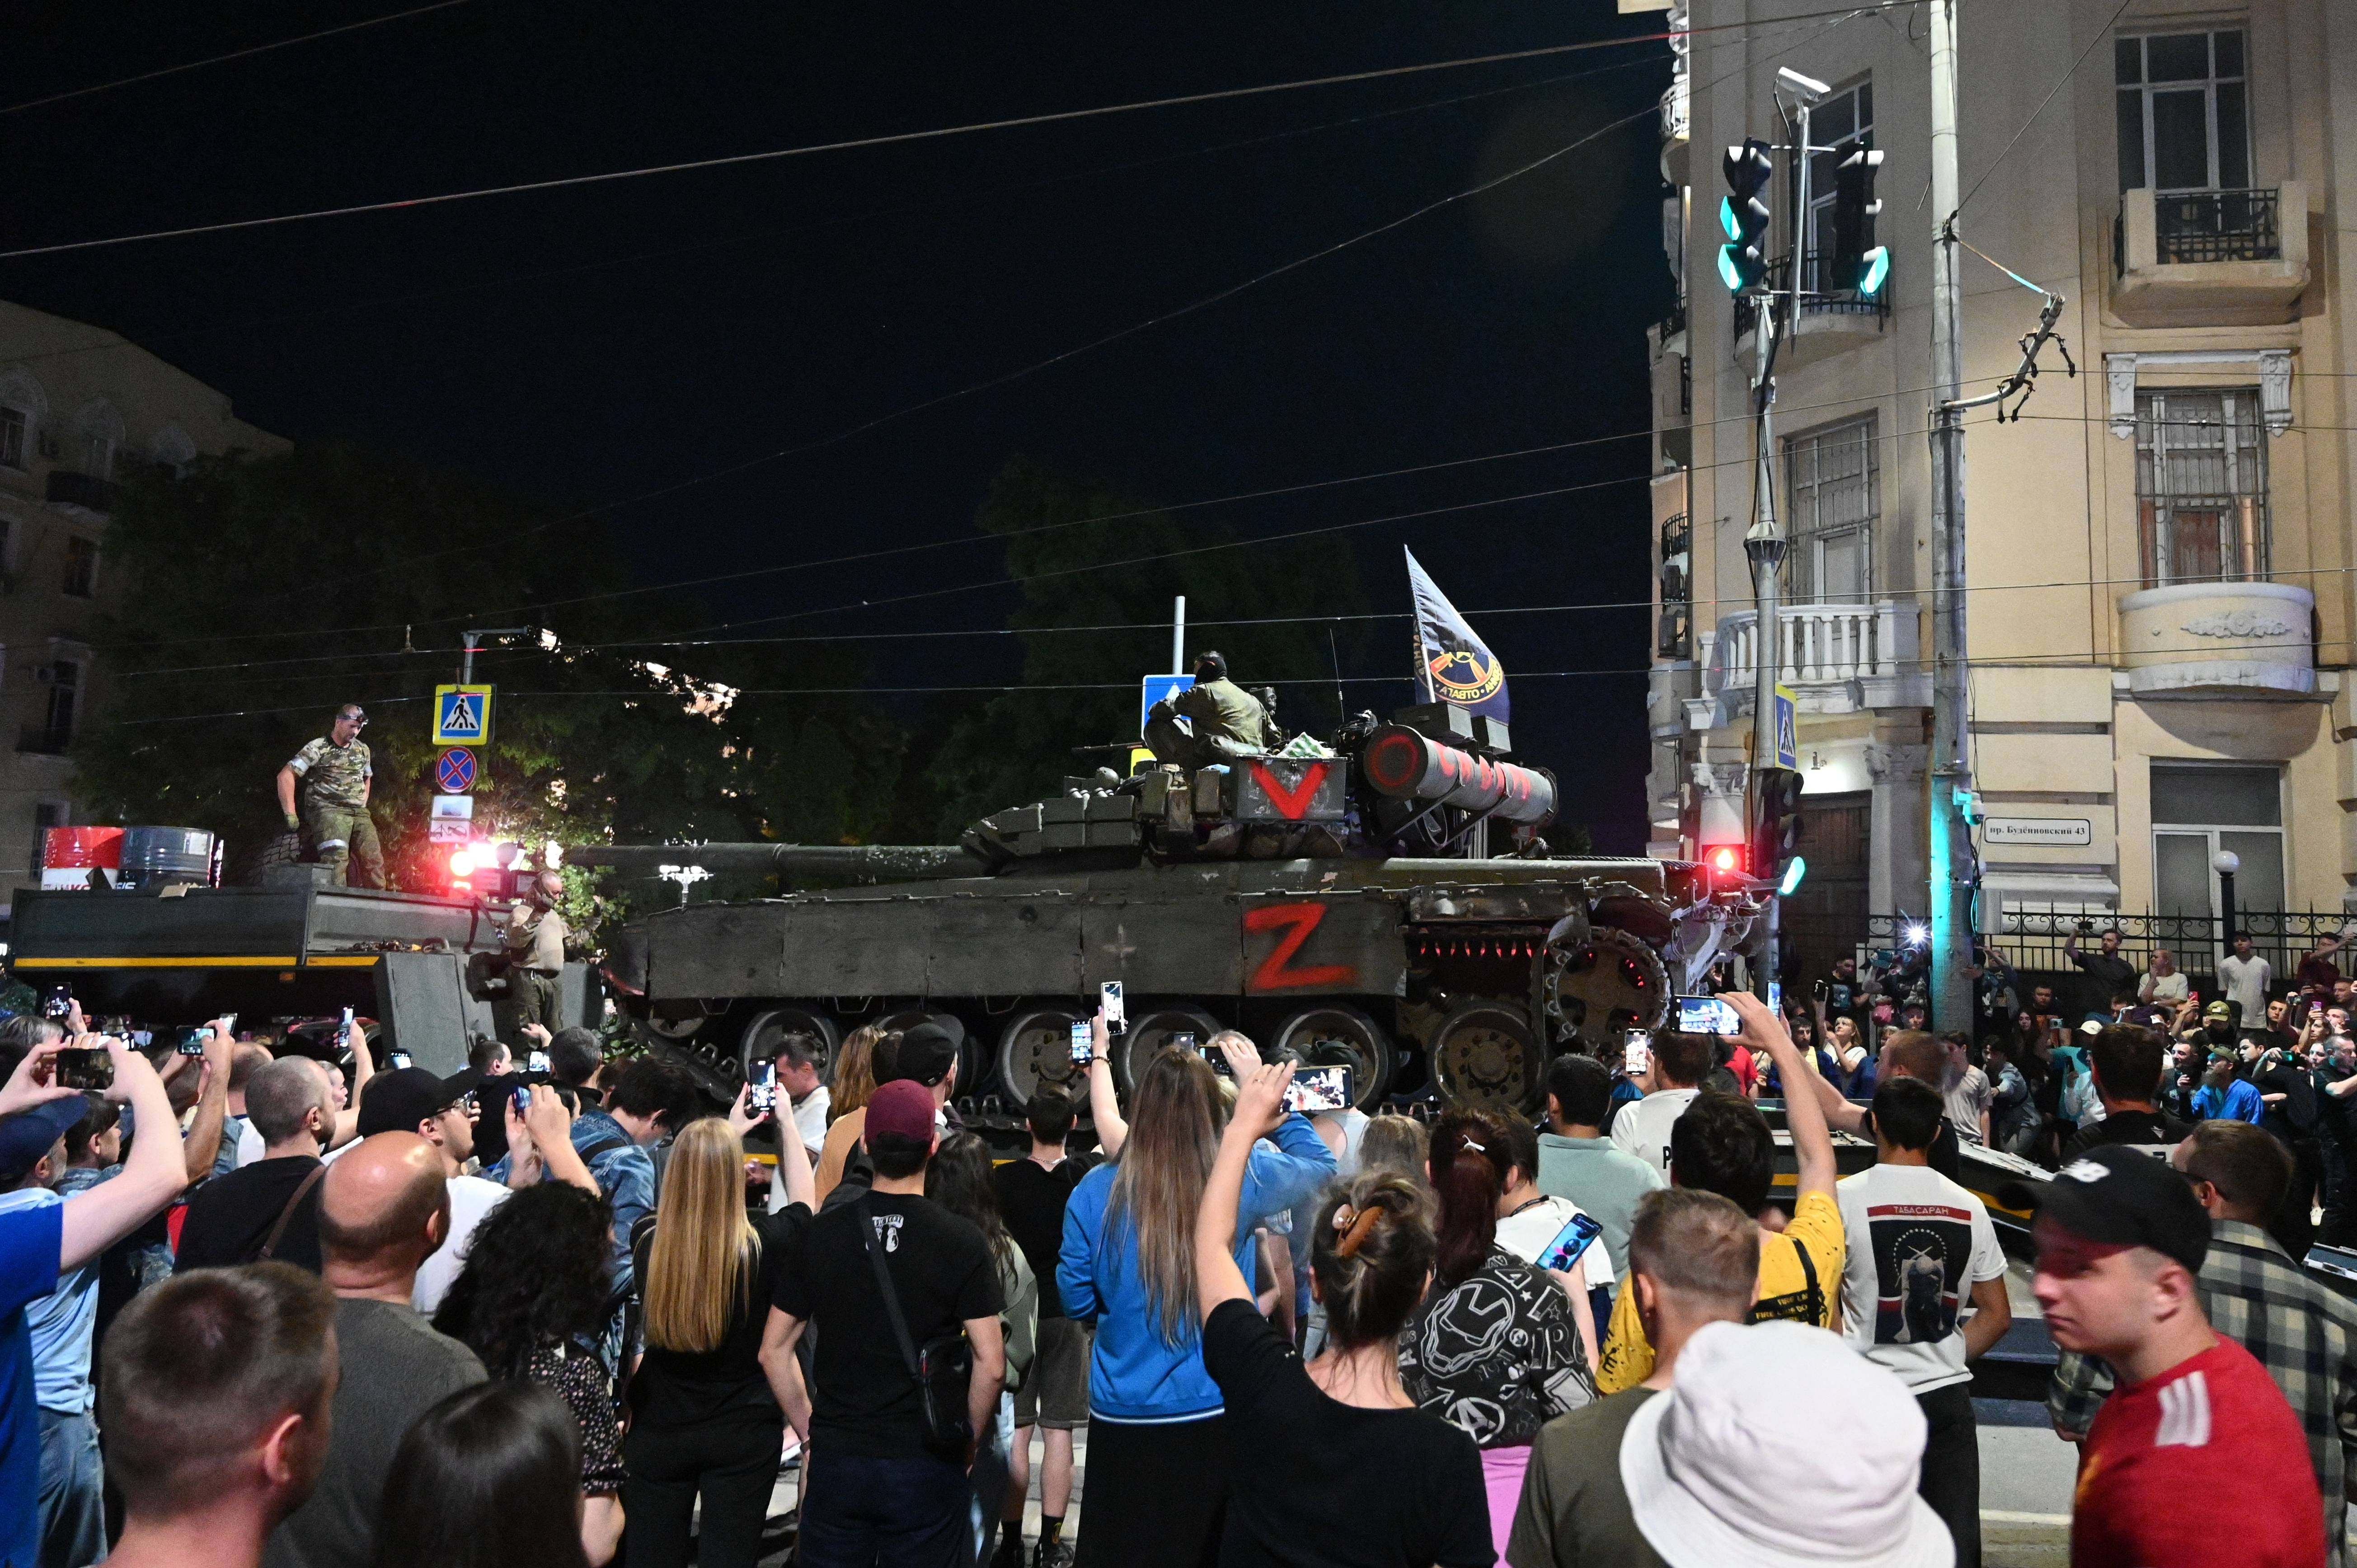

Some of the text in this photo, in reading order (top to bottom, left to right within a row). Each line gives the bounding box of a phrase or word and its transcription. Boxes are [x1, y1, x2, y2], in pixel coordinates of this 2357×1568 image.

[1248, 760, 1331, 820] V
[2007, 825, 2072, 835] Будённовский
[1244, 901, 1358, 990] Z
[1893, 1206, 1949, 1216] ТАБАСАРАН
